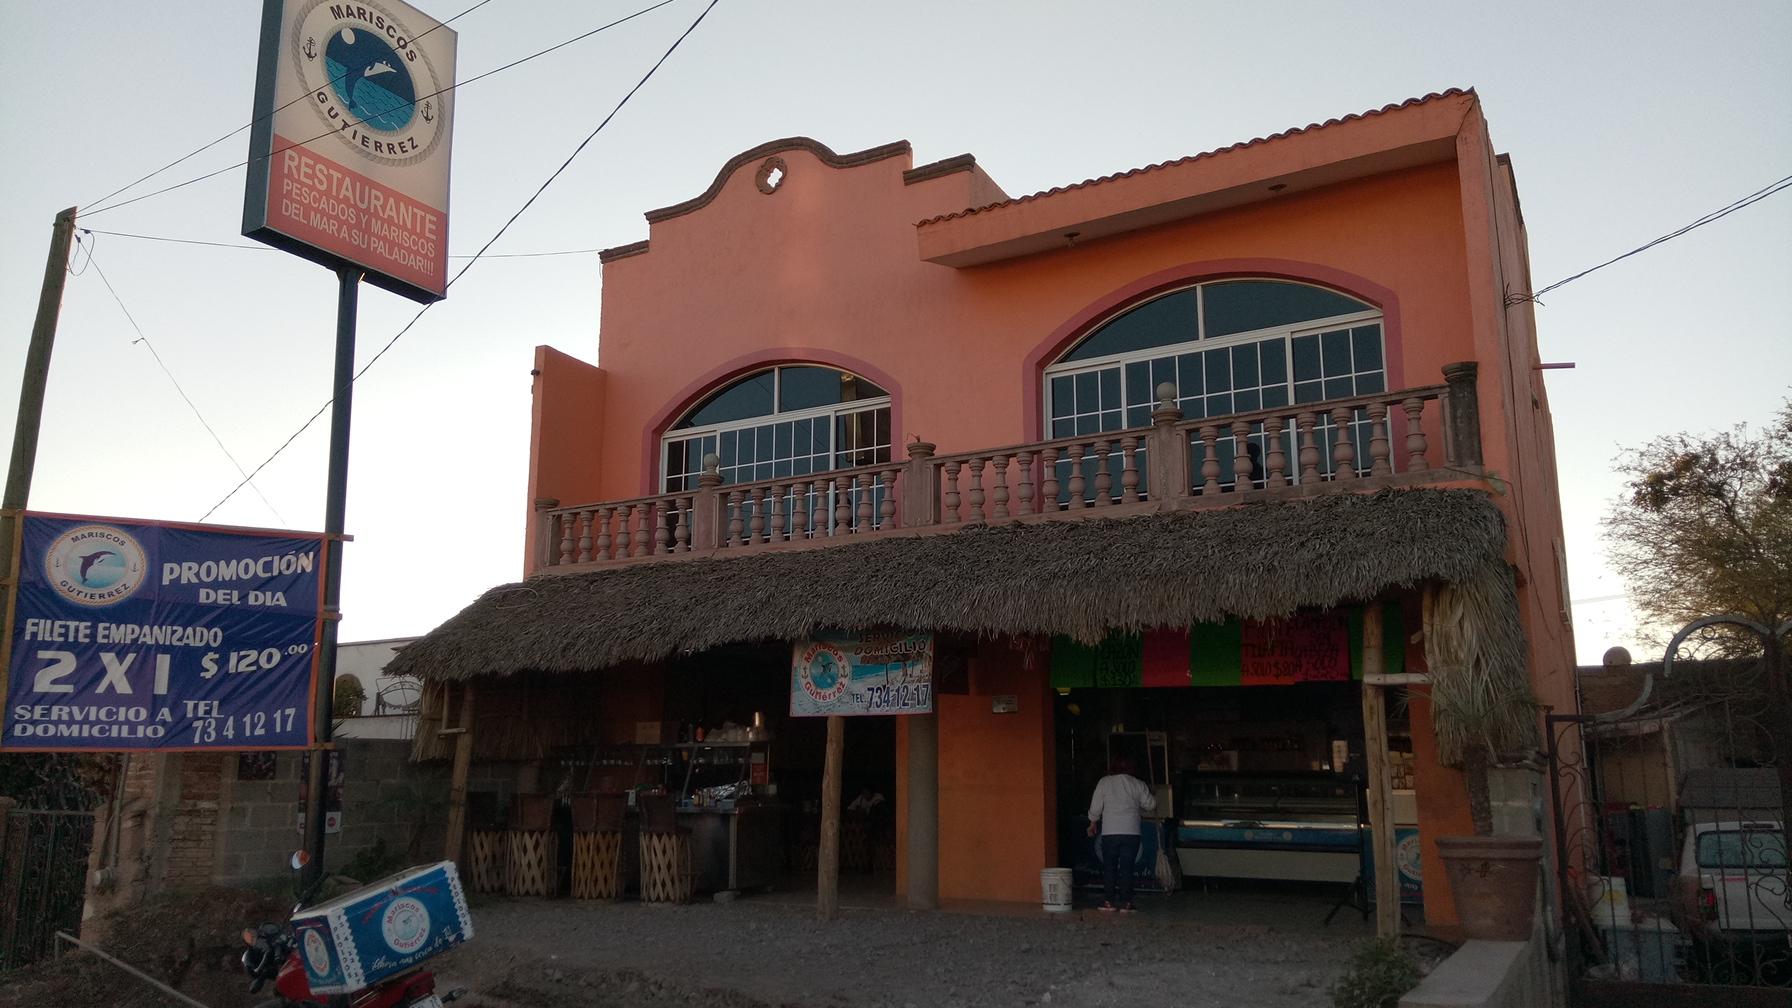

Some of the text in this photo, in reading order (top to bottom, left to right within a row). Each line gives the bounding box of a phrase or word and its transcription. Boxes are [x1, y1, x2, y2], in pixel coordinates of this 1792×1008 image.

[330, 4, 417, 62] MARISCOS
[316, 91, 418, 155] GUTIERREZ
[284, 149, 437, 240] RESTAURANTE
[283, 178, 435, 257] PESCADOS Y MARISCOS
[282, 199, 434, 276] DEL MAR A SU PALADAR!!!
[70, 531, 126, 547] MARISCOS
[162, 551, 314, 585] PROMOCIÓN
[60, 580, 130, 601] GUTIERREZ
[199, 589, 287, 607] DEL DIA
[25, 618, 222, 647] FILETE EMPANIZADO
[804, 643, 843, 663] Mariscos
[854, 640, 926, 656] DOMICILIO
[33, 651, 77, 693] 2
[95, 652, 137, 694] X
[200, 652, 219, 679] $
[804, 681, 846, 700] Gutiérrez
[867, 686, 891, 709] 734
[895, 685, 910, 707] 12
[914, 684, 929, 707] 17
[14, 705, 172, 722] SERVICIO A
[183, 700, 225, 718] TEL
[13, 723, 165, 738] DOMICILIO
[192, 708, 296, 744] 73 4 12 17
[386, 902, 420, 924] Mariscos
